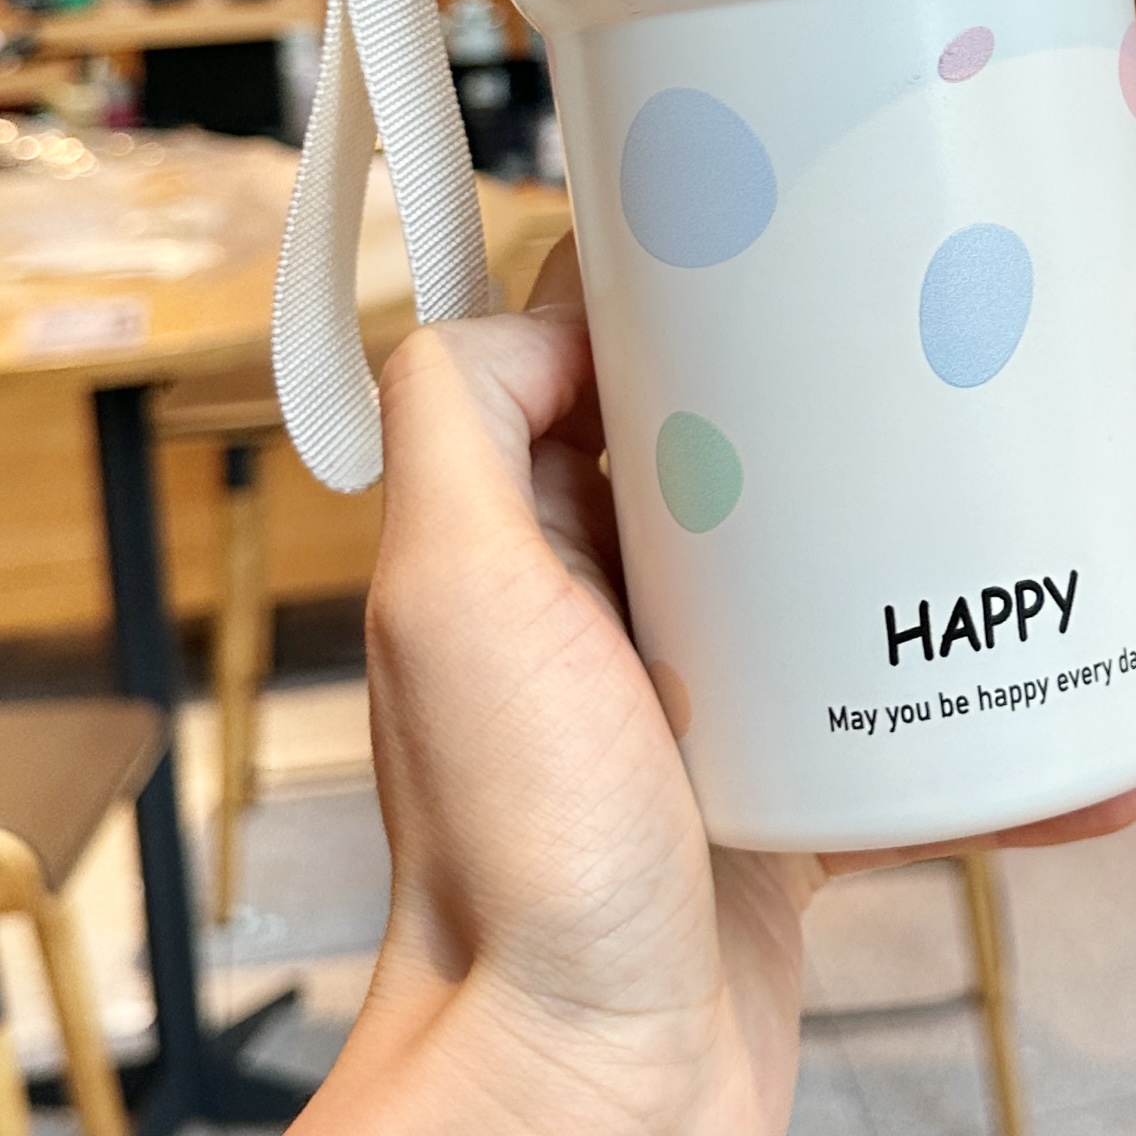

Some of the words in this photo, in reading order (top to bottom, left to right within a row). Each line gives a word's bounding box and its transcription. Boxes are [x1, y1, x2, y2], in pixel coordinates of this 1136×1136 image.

[883, 569, 1079, 667] HAPPY
[827, 705, 878, 736] May
[884, 700, 932, 734] you
[938, 692, 970, 719] be
[977, 676, 1049, 712] happy
[1056, 659, 1112, 693] every
